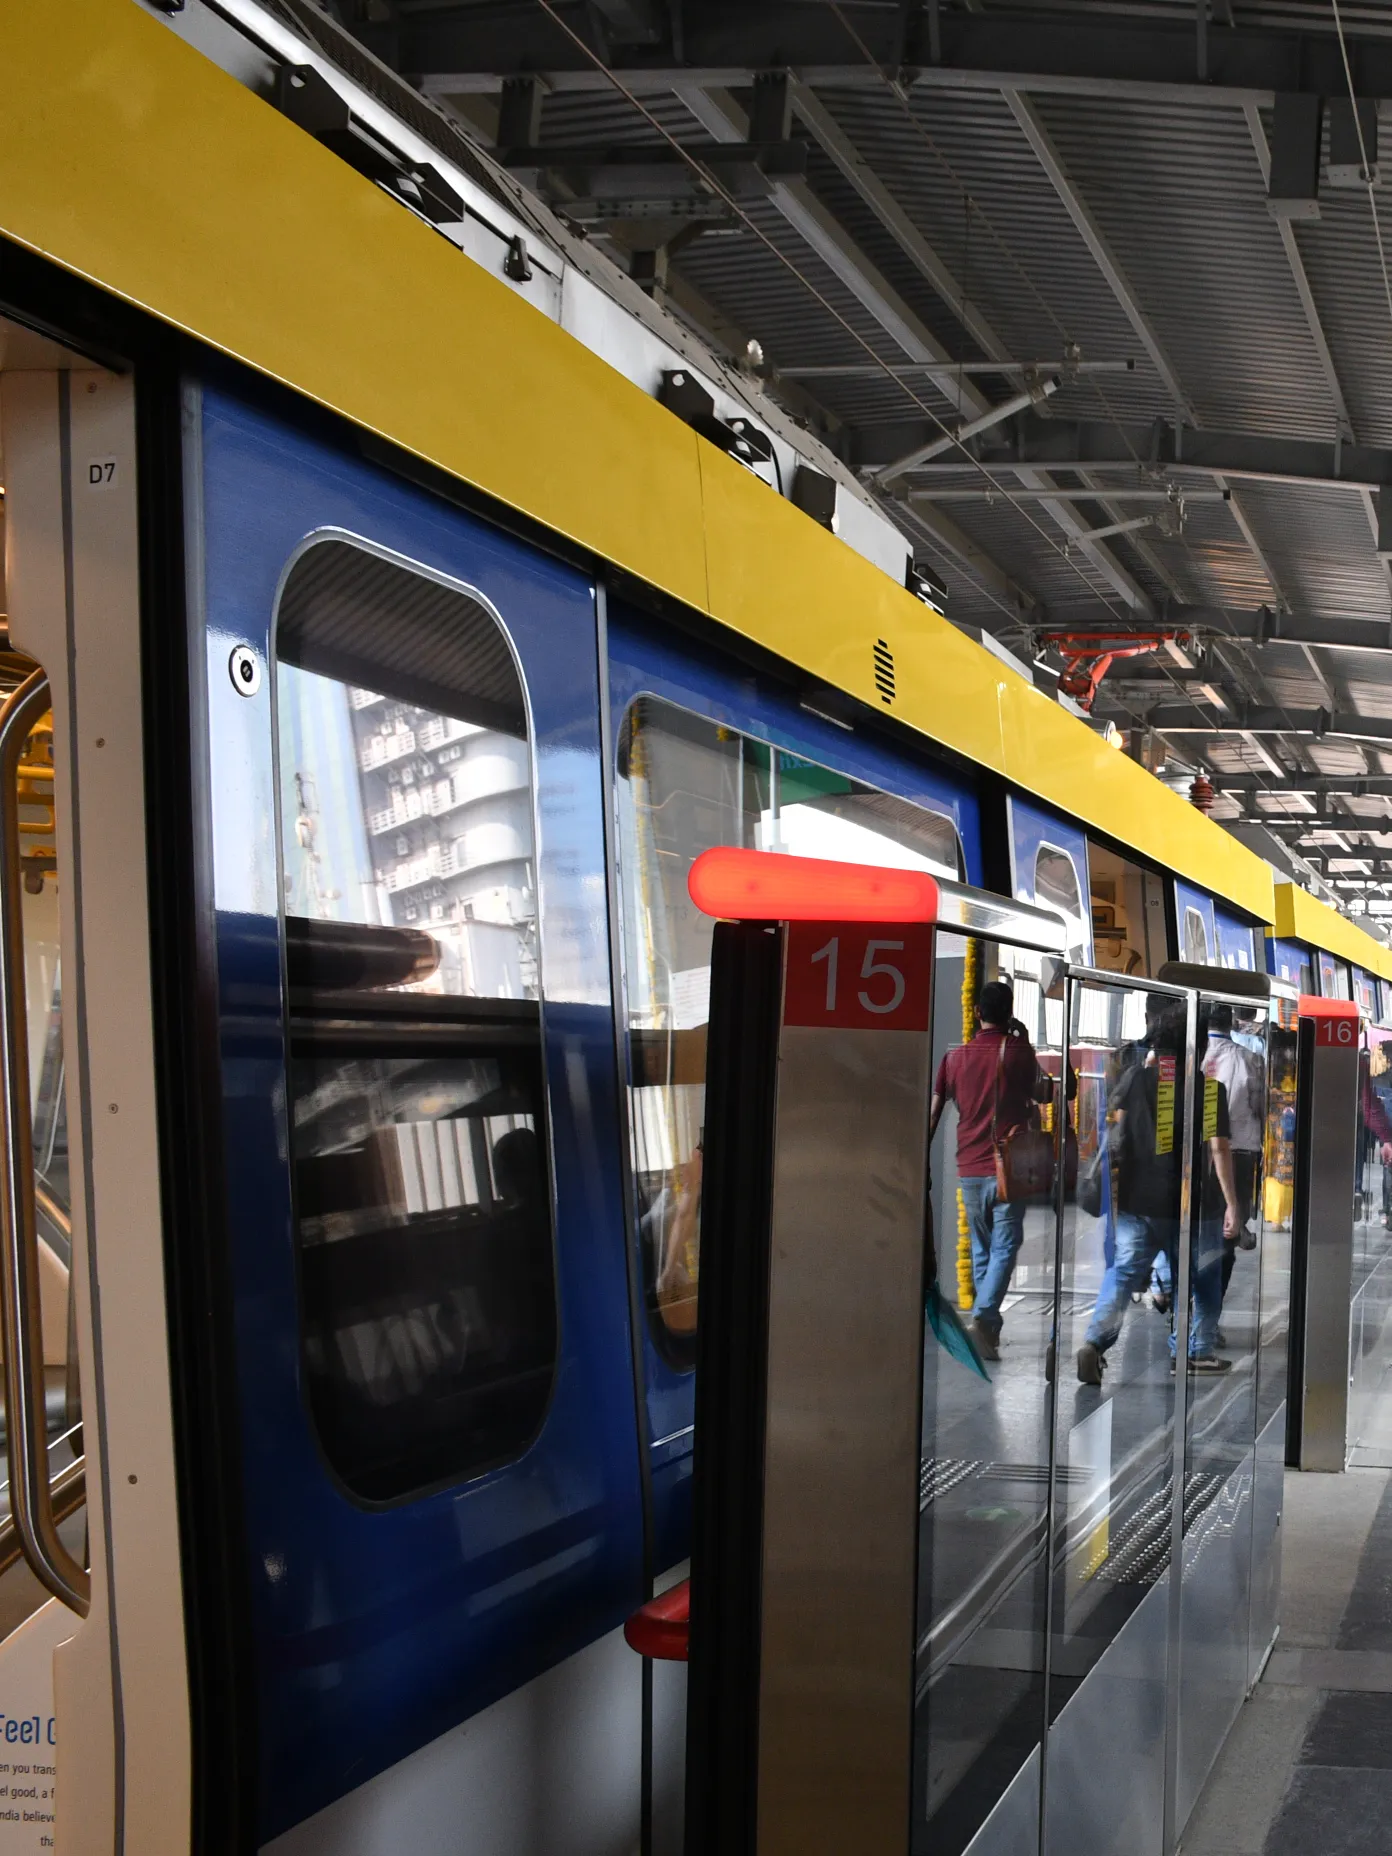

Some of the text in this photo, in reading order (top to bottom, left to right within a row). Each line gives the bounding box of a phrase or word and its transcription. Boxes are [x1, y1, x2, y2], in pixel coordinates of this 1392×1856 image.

[89, 462, 116, 484] D7
[810, 938, 907, 1016] 15
[1322, 1020, 1352, 1043] 16
[12, 1764, 30, 1776] you
[11, 1787, 38, 1799] good,
[42, 1790, 48, 1798] a
